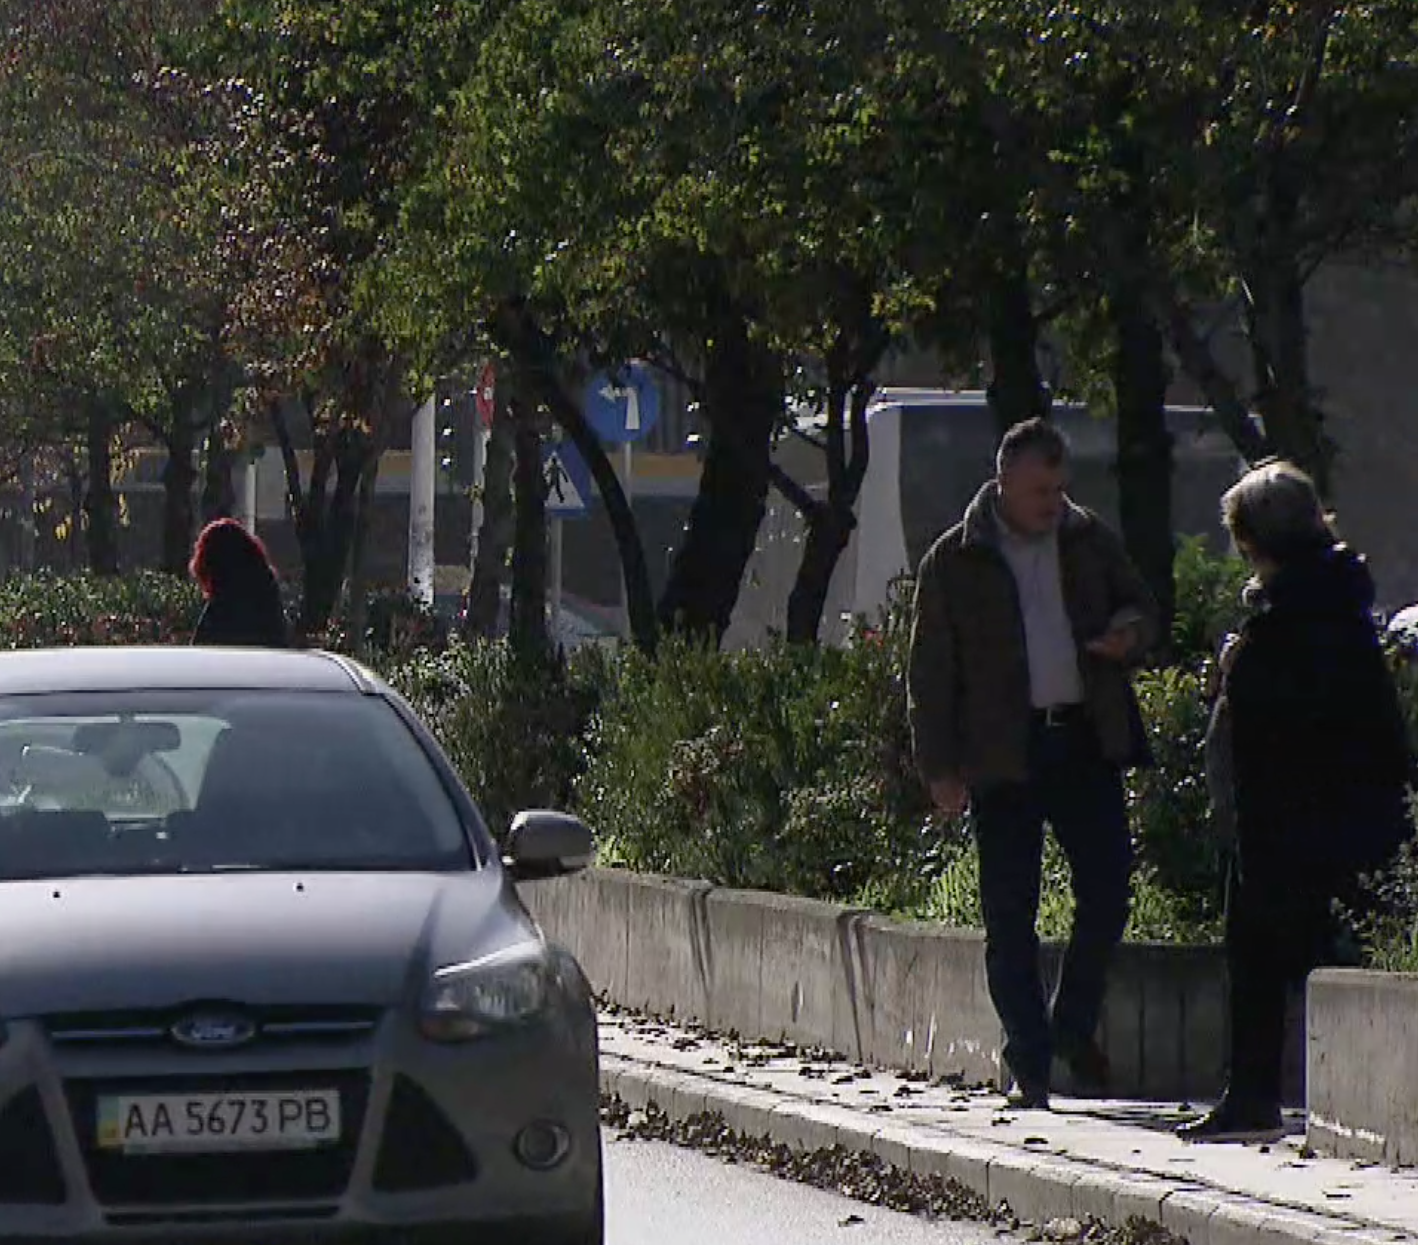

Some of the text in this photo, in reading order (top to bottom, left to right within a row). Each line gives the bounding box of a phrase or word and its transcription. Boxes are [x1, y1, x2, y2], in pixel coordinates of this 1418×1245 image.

[124, 1098, 330, 1138] AA 5673 PB
